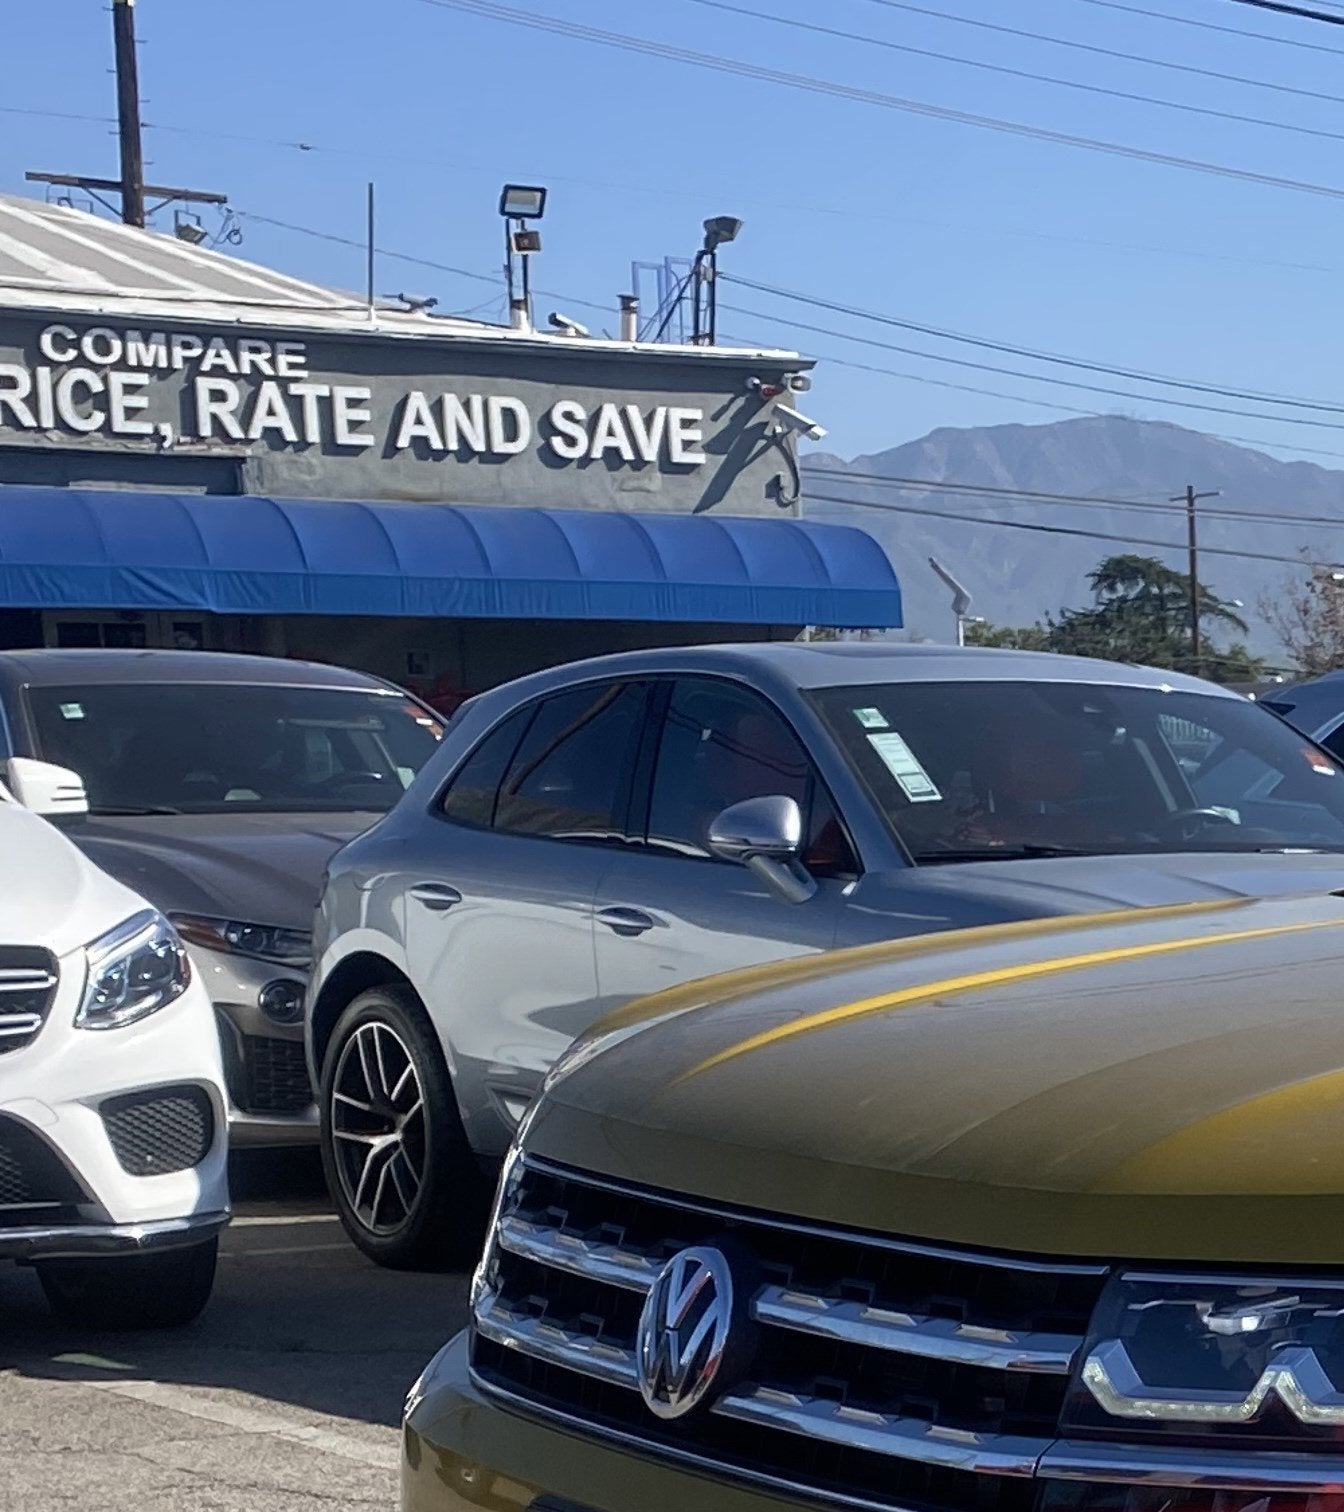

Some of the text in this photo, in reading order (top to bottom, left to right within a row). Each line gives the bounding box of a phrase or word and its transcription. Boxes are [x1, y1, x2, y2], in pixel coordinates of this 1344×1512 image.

[40, 324, 309, 378] COMPARE
[195, 375, 375, 446] RATE
[396, 391, 532, 453] AND
[550, 400, 706, 464] SAVE
